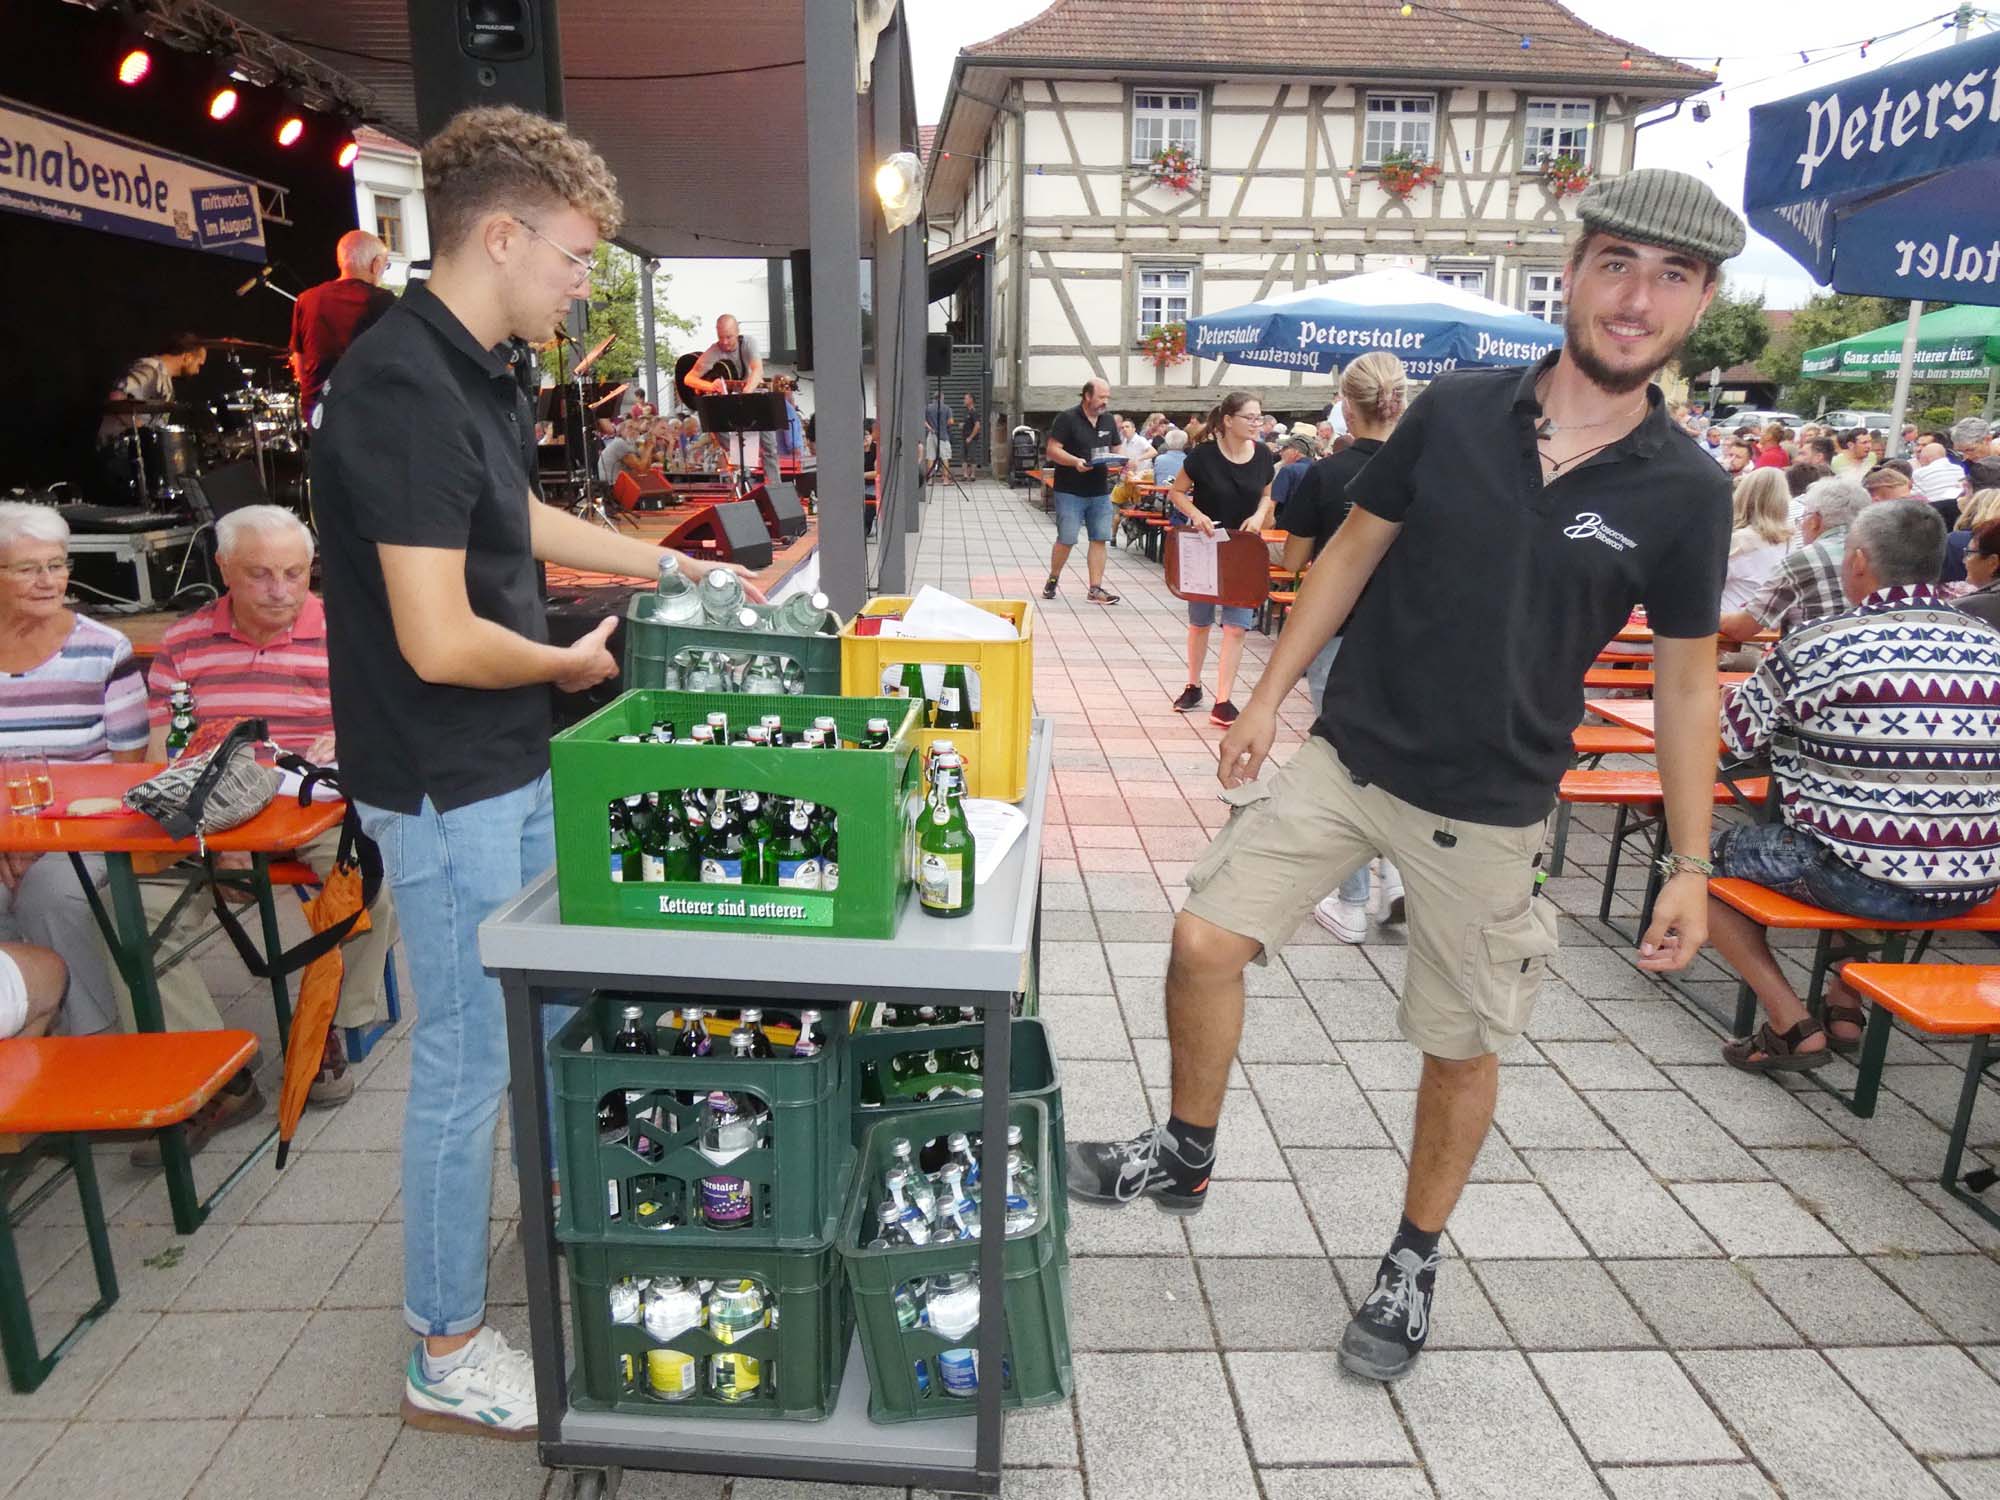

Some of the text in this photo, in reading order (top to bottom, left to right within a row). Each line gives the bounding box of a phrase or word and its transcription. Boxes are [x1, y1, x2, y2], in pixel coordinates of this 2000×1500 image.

[201, 189, 249, 211] mittwochs
[204, 217, 252, 238] im August
[1196, 324, 1262, 351] Peterstaler
[1297, 320, 1425, 349] Peterstaler
[1843, 350, 1870, 365] Ganz
[1871, 349, 1902, 364] schön
[1912, 350, 1948, 363] etterer
[1948, 346, 1975, 362] hier.
[659, 895, 808, 919] Ketterer sind netterer.
